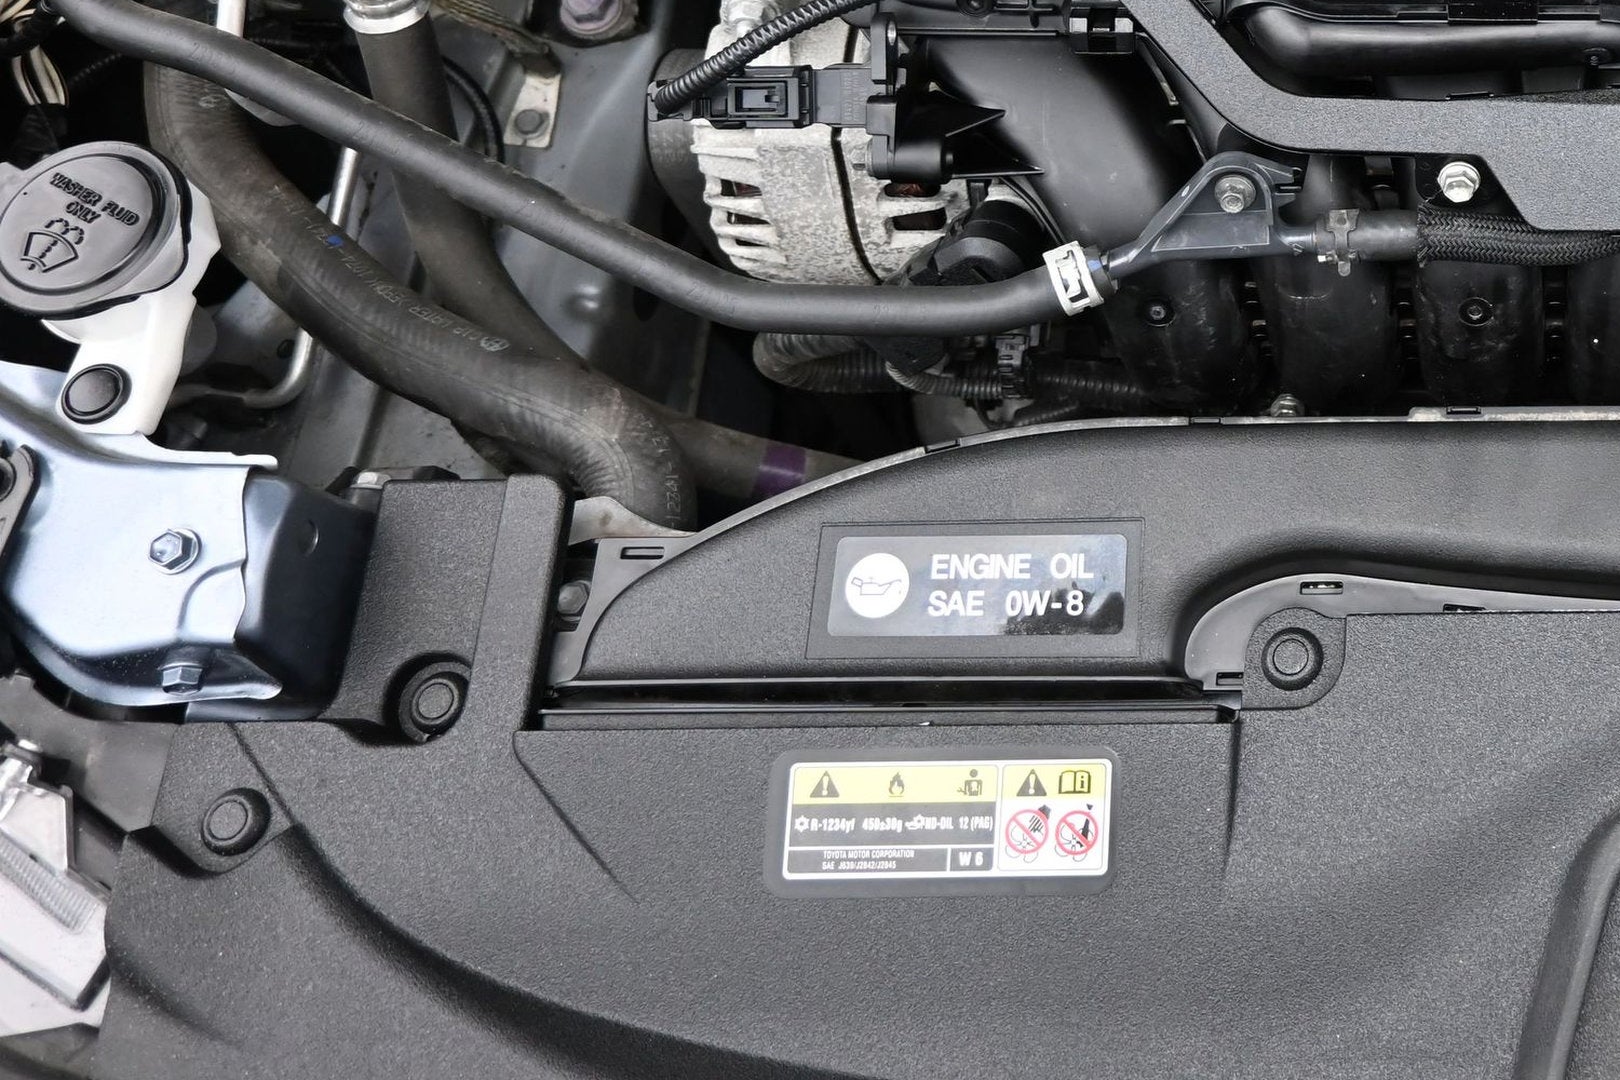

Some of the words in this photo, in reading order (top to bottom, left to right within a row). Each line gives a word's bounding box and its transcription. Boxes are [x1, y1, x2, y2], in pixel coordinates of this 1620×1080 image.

[50, 172, 102, 207] WASHER
[102, 201, 140, 226] FLUID
[65, 201, 102, 224] ONLY
[930, 553, 1033, 580] ENGINE
[1049, 552, 1095, 579] OIL
[927, 590, 985, 617] SAE
[1005, 589, 1084, 617] 0W-8
[810, 817, 855, 833] R-1234yf
[959, 815, 968, 829] 12
[823, 850, 847, 859] TOYOTA
[848, 849, 871, 859] MOTOR
[872, 848, 915, 858] CORPORATION
[959, 852, 973, 867] W
[976, 851, 984, 866] 6
[822, 861, 835, 870] SAE
